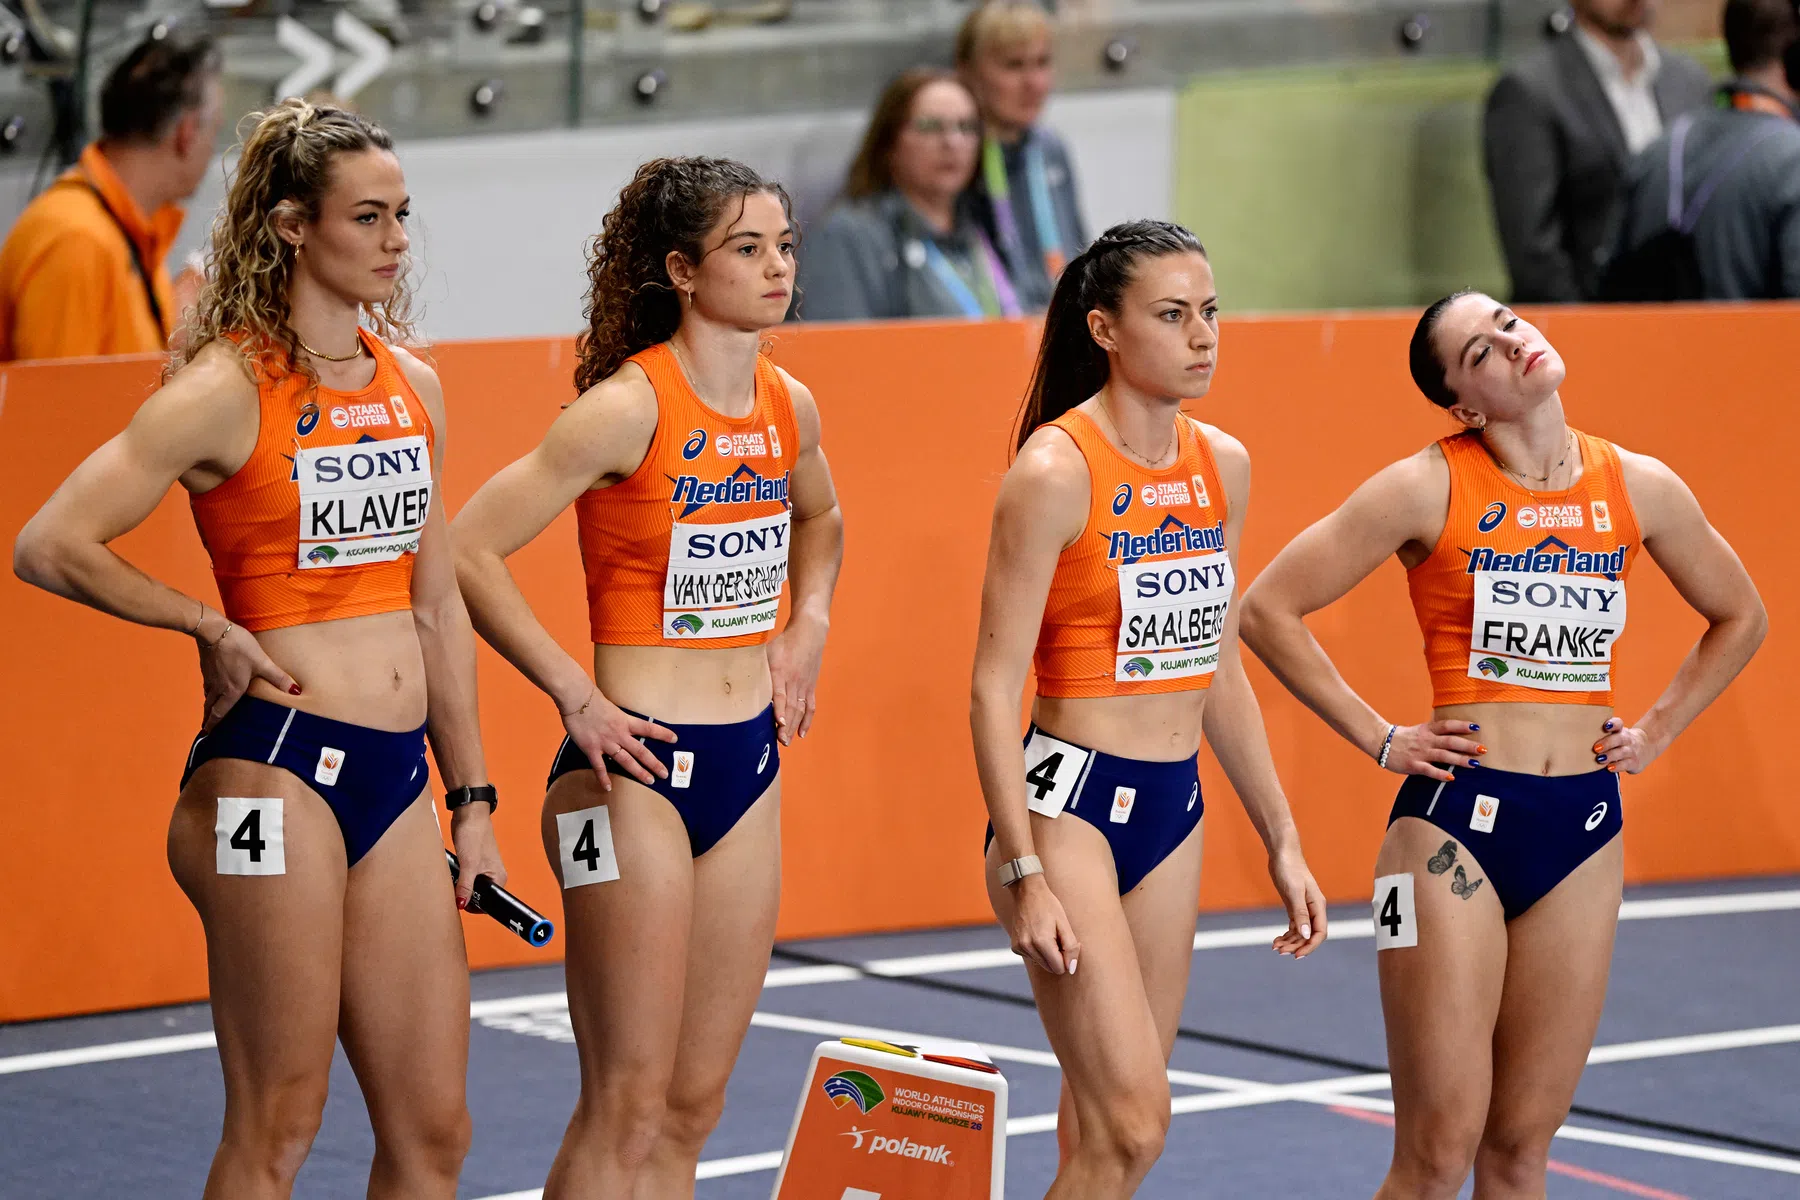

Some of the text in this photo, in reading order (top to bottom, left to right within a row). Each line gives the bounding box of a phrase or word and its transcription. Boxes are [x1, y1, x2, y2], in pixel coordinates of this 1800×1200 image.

[348, 404, 387, 417] STAATS
[350, 414, 390, 427] LOTERIJ
[732, 433, 764, 446] STAATS
[733, 444, 767, 457] LOTERIJ
[314, 447, 421, 483] SONY
[1157, 482, 1188, 494] STAATS
[1158, 492, 1191, 506] LOTERIJ
[311, 487, 429, 536] KLAVER
[1538, 505, 1582, 517] STAATS
[1540, 516, 1583, 528] LOTERIJ
[687, 522, 788, 560] SONY
[673, 574, 711, 605] VAN
[713, 570, 744, 603] DER
[1135, 562, 1225, 599] SONY
[1491, 580, 1618, 613] SONY
[711, 616, 749, 629] KUJAWY
[1125, 601, 1227, 648] SAALBERG
[1482, 620, 1615, 658] FRANKE
[1160, 658, 1193, 671] KUJAWY
[1516, 667, 1561, 682] KUJAWY
[1562, 673, 1598, 682] POMORZE
[1026, 752, 1065, 801] 4
[229, 809, 266, 862] 4
[572, 819, 601, 872] 4
[1379, 886, 1402, 937] 4
[892, 1097, 984, 1122] INDOOR CHAMPIONSHIPS
[894, 1087, 985, 1114] WORLD ATHLETICS
[891, 1105, 983, 1131] KUJAWY POMORZE 26
[867, 1135, 952, 1165] polanik
